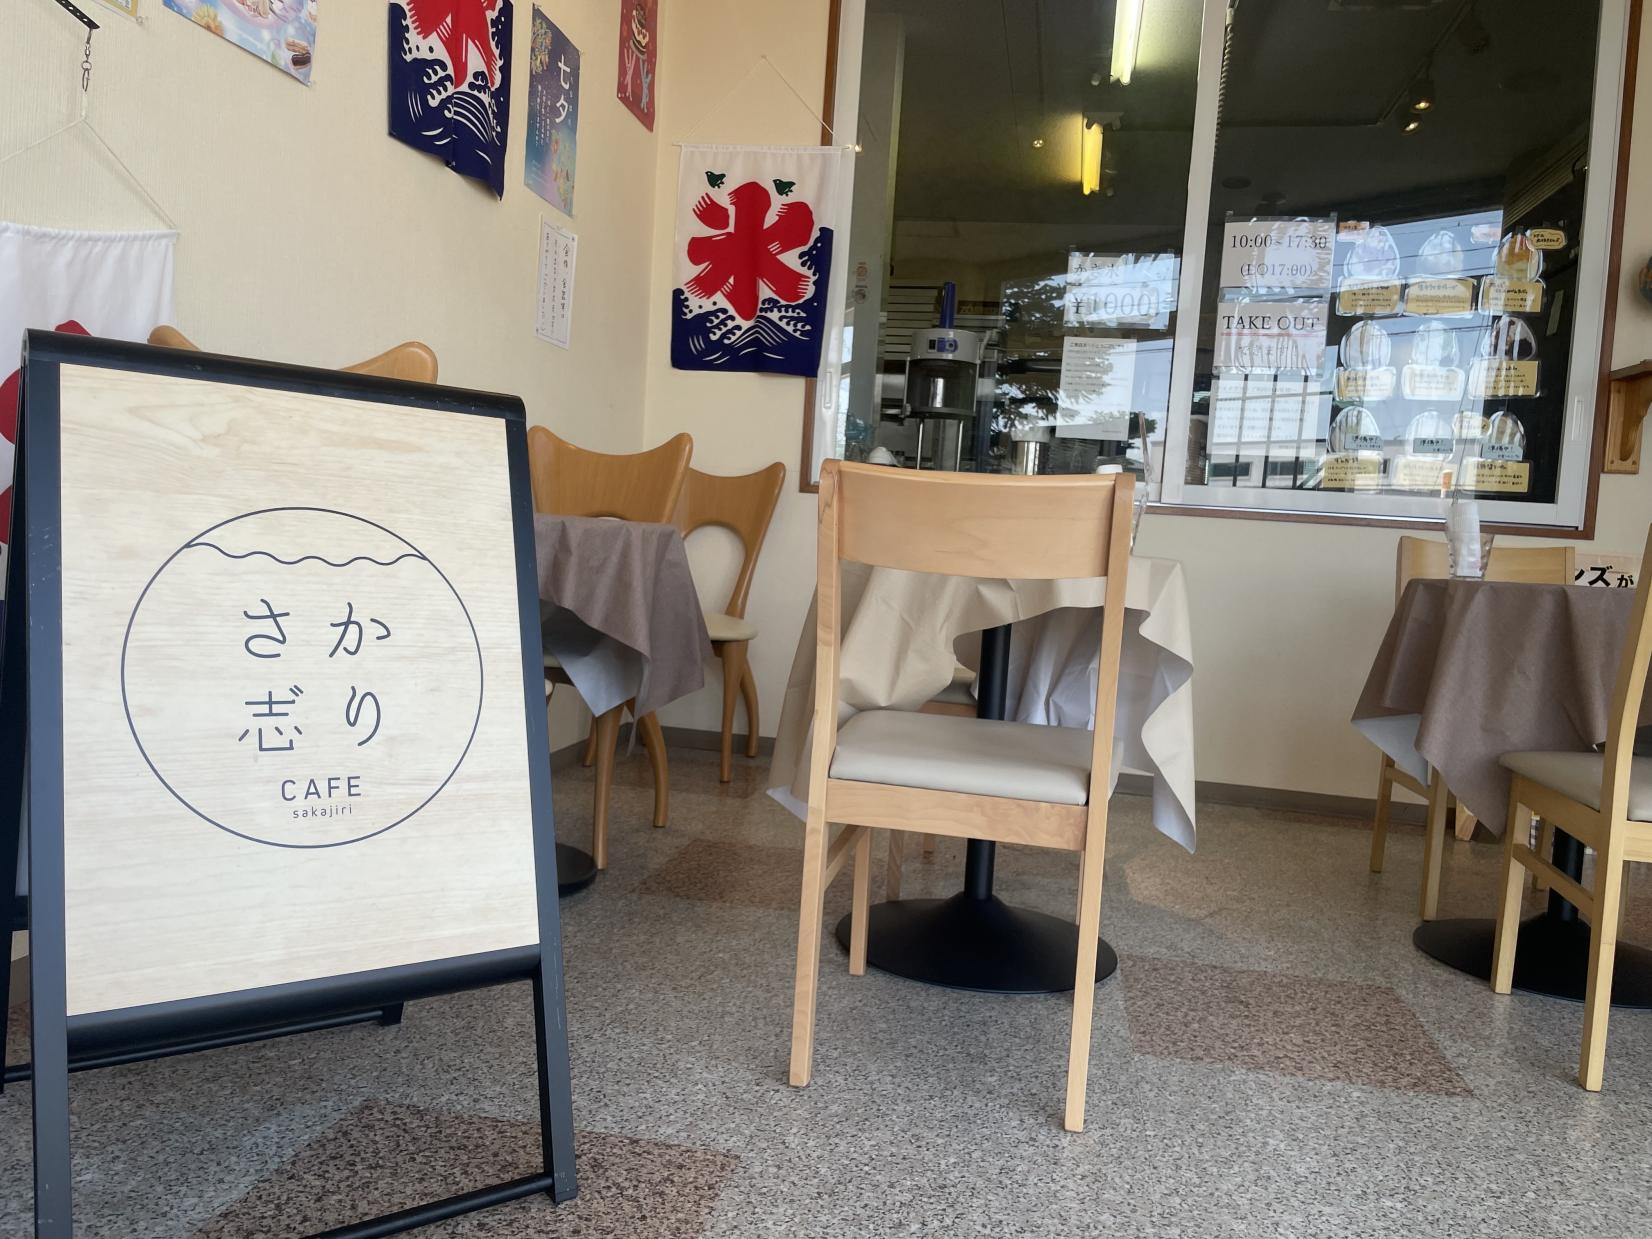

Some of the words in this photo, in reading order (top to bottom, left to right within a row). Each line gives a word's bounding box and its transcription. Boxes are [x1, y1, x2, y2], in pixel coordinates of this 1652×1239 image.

[555, 54, 571, 124] 七夕
[1222, 315, 1272, 330] TAKE
[1277, 315, 1320, 331] OUT
[281, 776, 362, 802] CAFE
[292, 804, 352, 819] sakajiri
